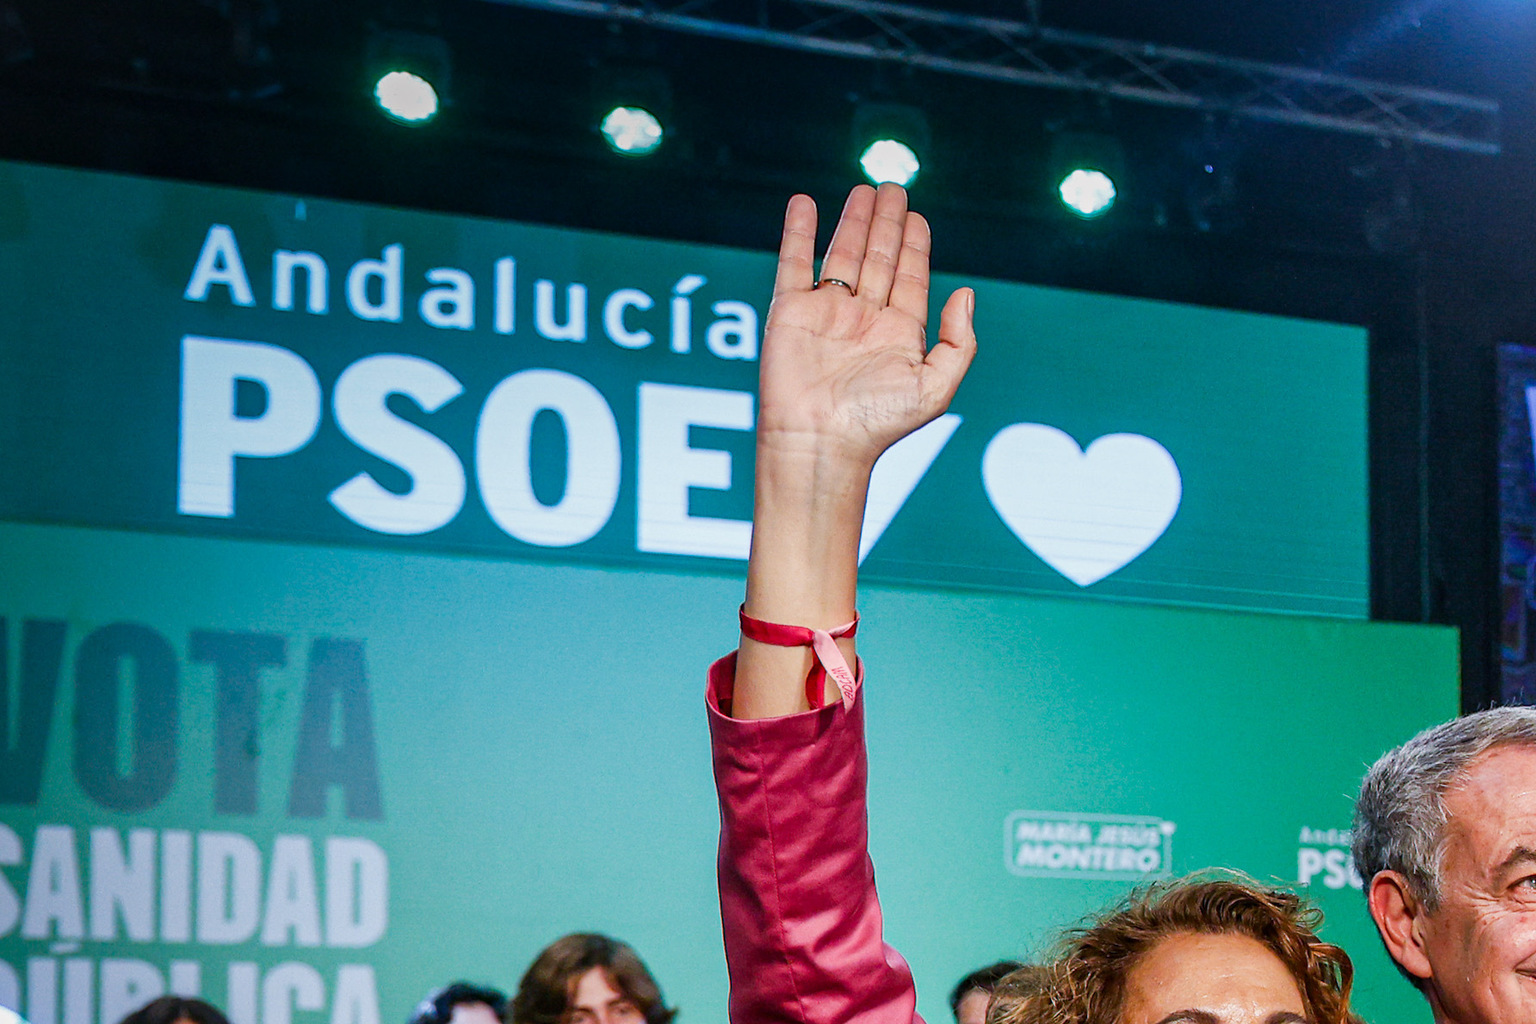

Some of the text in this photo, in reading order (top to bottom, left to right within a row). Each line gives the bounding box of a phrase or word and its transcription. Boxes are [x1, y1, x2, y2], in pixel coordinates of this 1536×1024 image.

[186, 224, 758, 361] Andalucía
[177, 334, 757, 561] PSOE
[0, 617, 385, 821] VOTA
[1016, 843, 1161, 872] MONTERO
